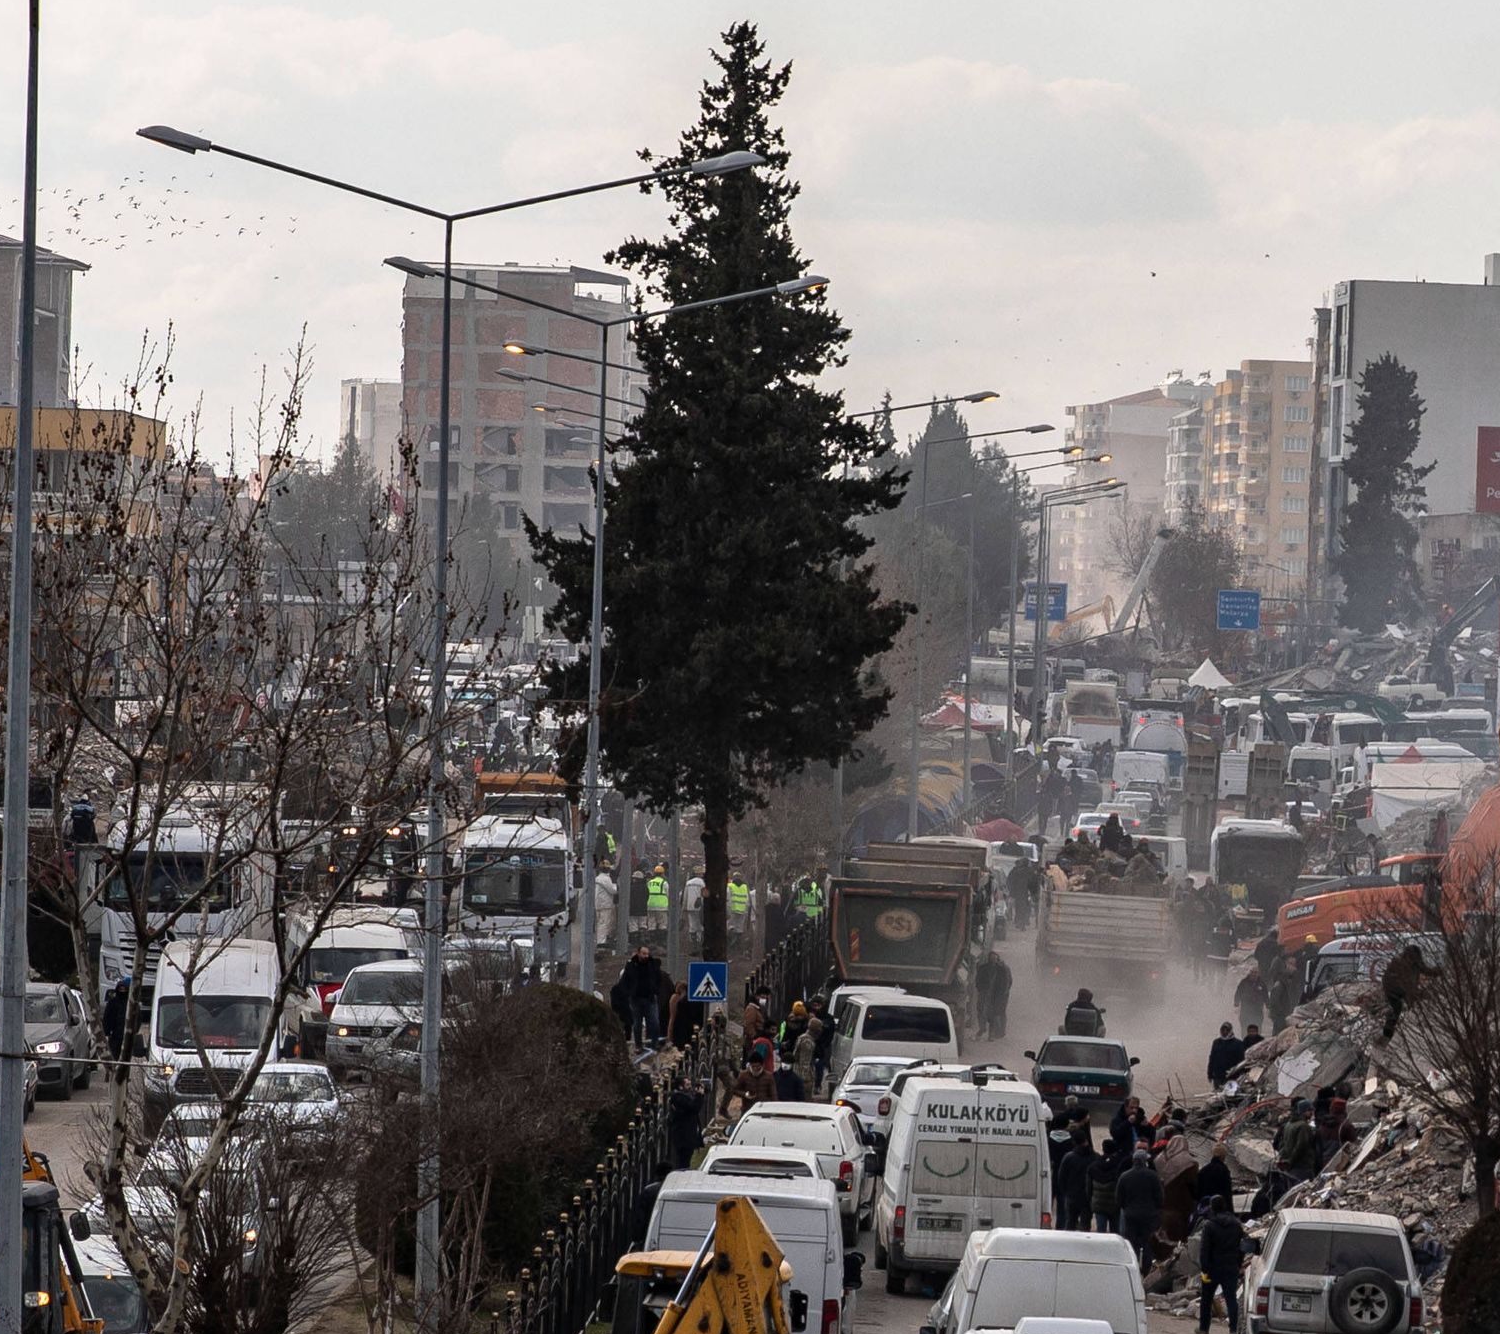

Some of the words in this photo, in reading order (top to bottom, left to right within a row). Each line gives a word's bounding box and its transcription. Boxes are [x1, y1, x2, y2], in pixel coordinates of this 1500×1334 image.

[927, 1104, 982, 1121] KULAK
[985, 1104, 1029, 1123] KÖYÜ
[918, 1124, 947, 1133] CENAZE
[950, 1125, 977, 1134] YIKAMA
[980, 1127, 990, 1135] VE
[992, 1126, 1013, 1136] NAKİL
[1015, 1129, 1037, 1137] ARACI
